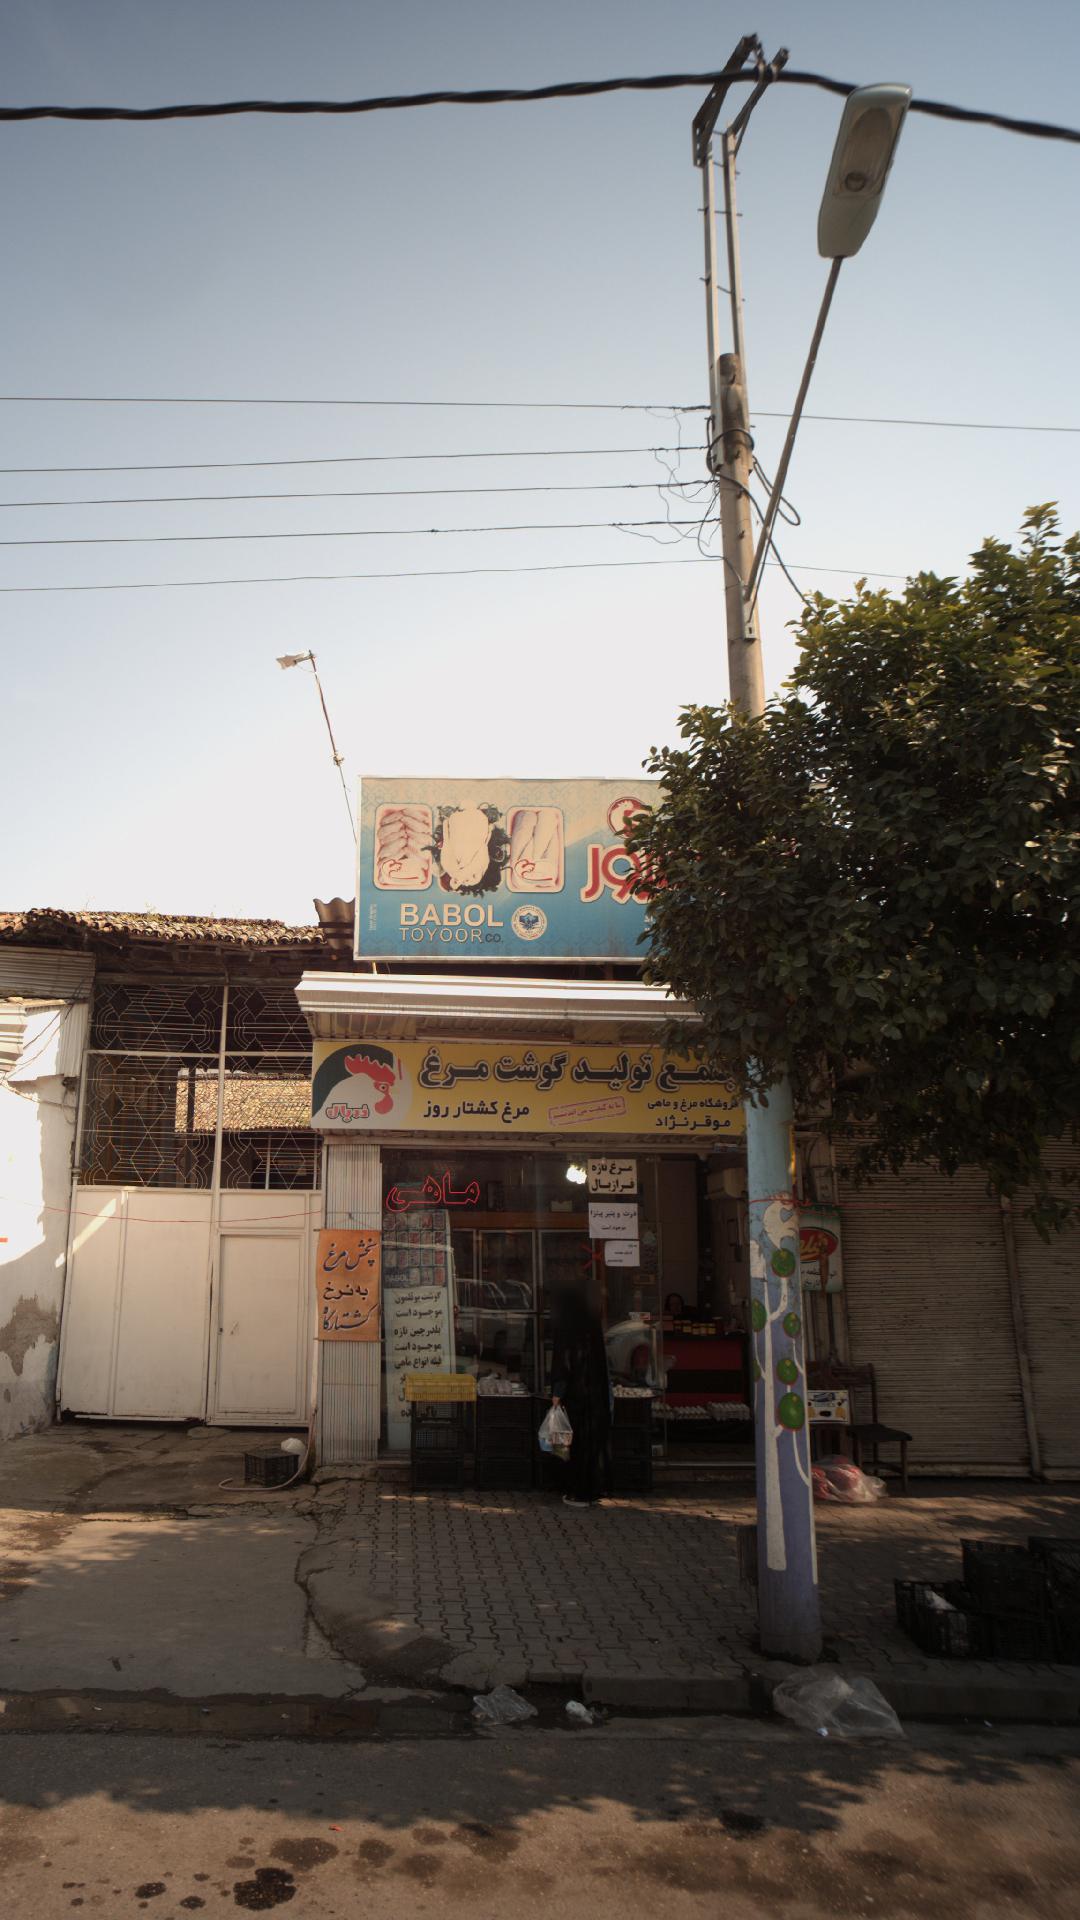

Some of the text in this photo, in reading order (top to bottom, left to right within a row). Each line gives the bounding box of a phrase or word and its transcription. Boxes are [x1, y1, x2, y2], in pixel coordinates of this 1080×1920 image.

[400, 903, 503, 927] BABOL
[400, 927, 482, 943] TOYOOR
[419, 1047, 489, 1088] مرغ
[494, 1050, 568, 1090] گوشت
[573, 1051, 653, 1091] تولید
[424, 1101, 529, 1123] مرغ کشتار روز
[648, 1099, 671, 1109] ماهی
[679, 1098, 698, 1112] مرغ
[609, 1162, 632, 1175] مرغ
[385, 1170, 481, 1213] ماهی
[323, 1238, 377, 1272] پخش مرغ
[323, 1281, 369, 1301] به نرخ
[323, 1303, 378, 1331] کشتارگاه
[396, 1308, 442, 1320] موجود است
[394, 1342, 442, 1353] موجود است
